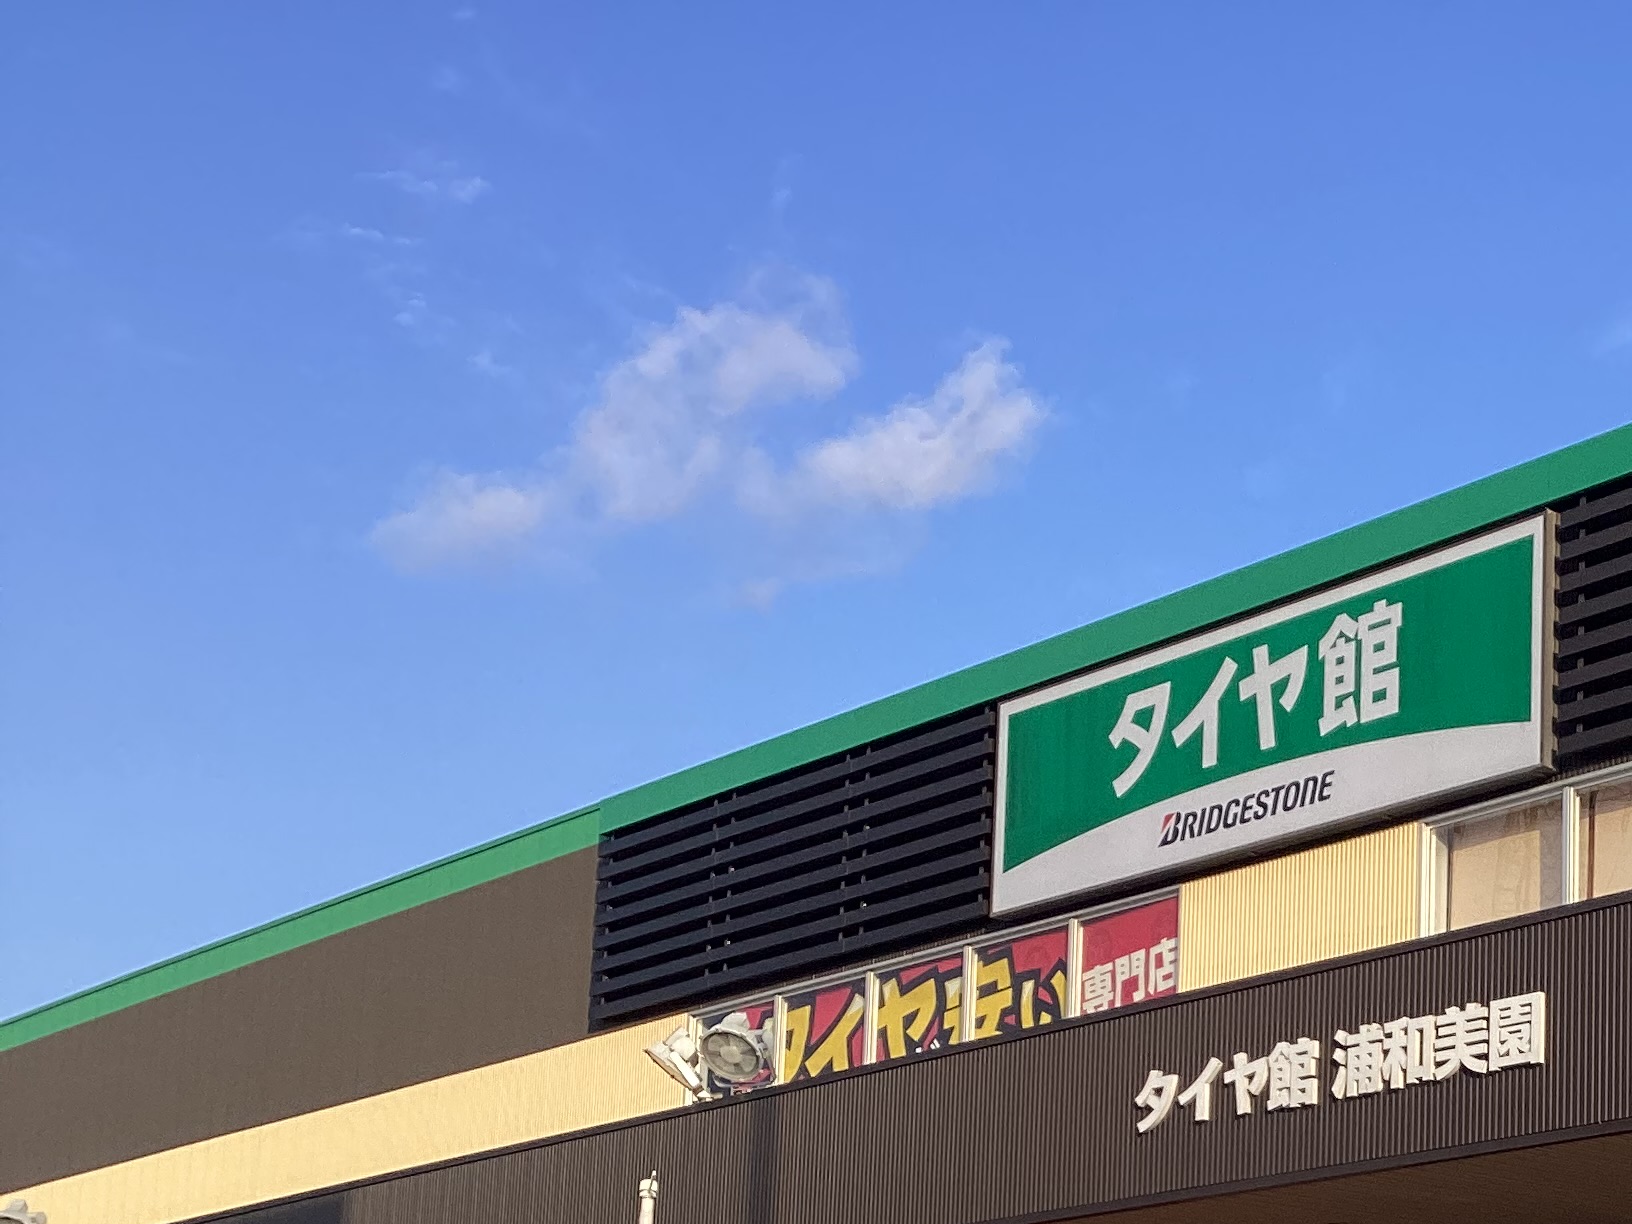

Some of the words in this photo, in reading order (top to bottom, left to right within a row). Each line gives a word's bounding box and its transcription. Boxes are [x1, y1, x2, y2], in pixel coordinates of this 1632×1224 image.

[1108, 599, 1402, 798] タイヤ館
[1158, 769, 1336, 849] BRIDGESTONE
[1135, 1037, 1319, 1134] タイヤ館
[1331, 991, 1546, 1100] 浦和美園
